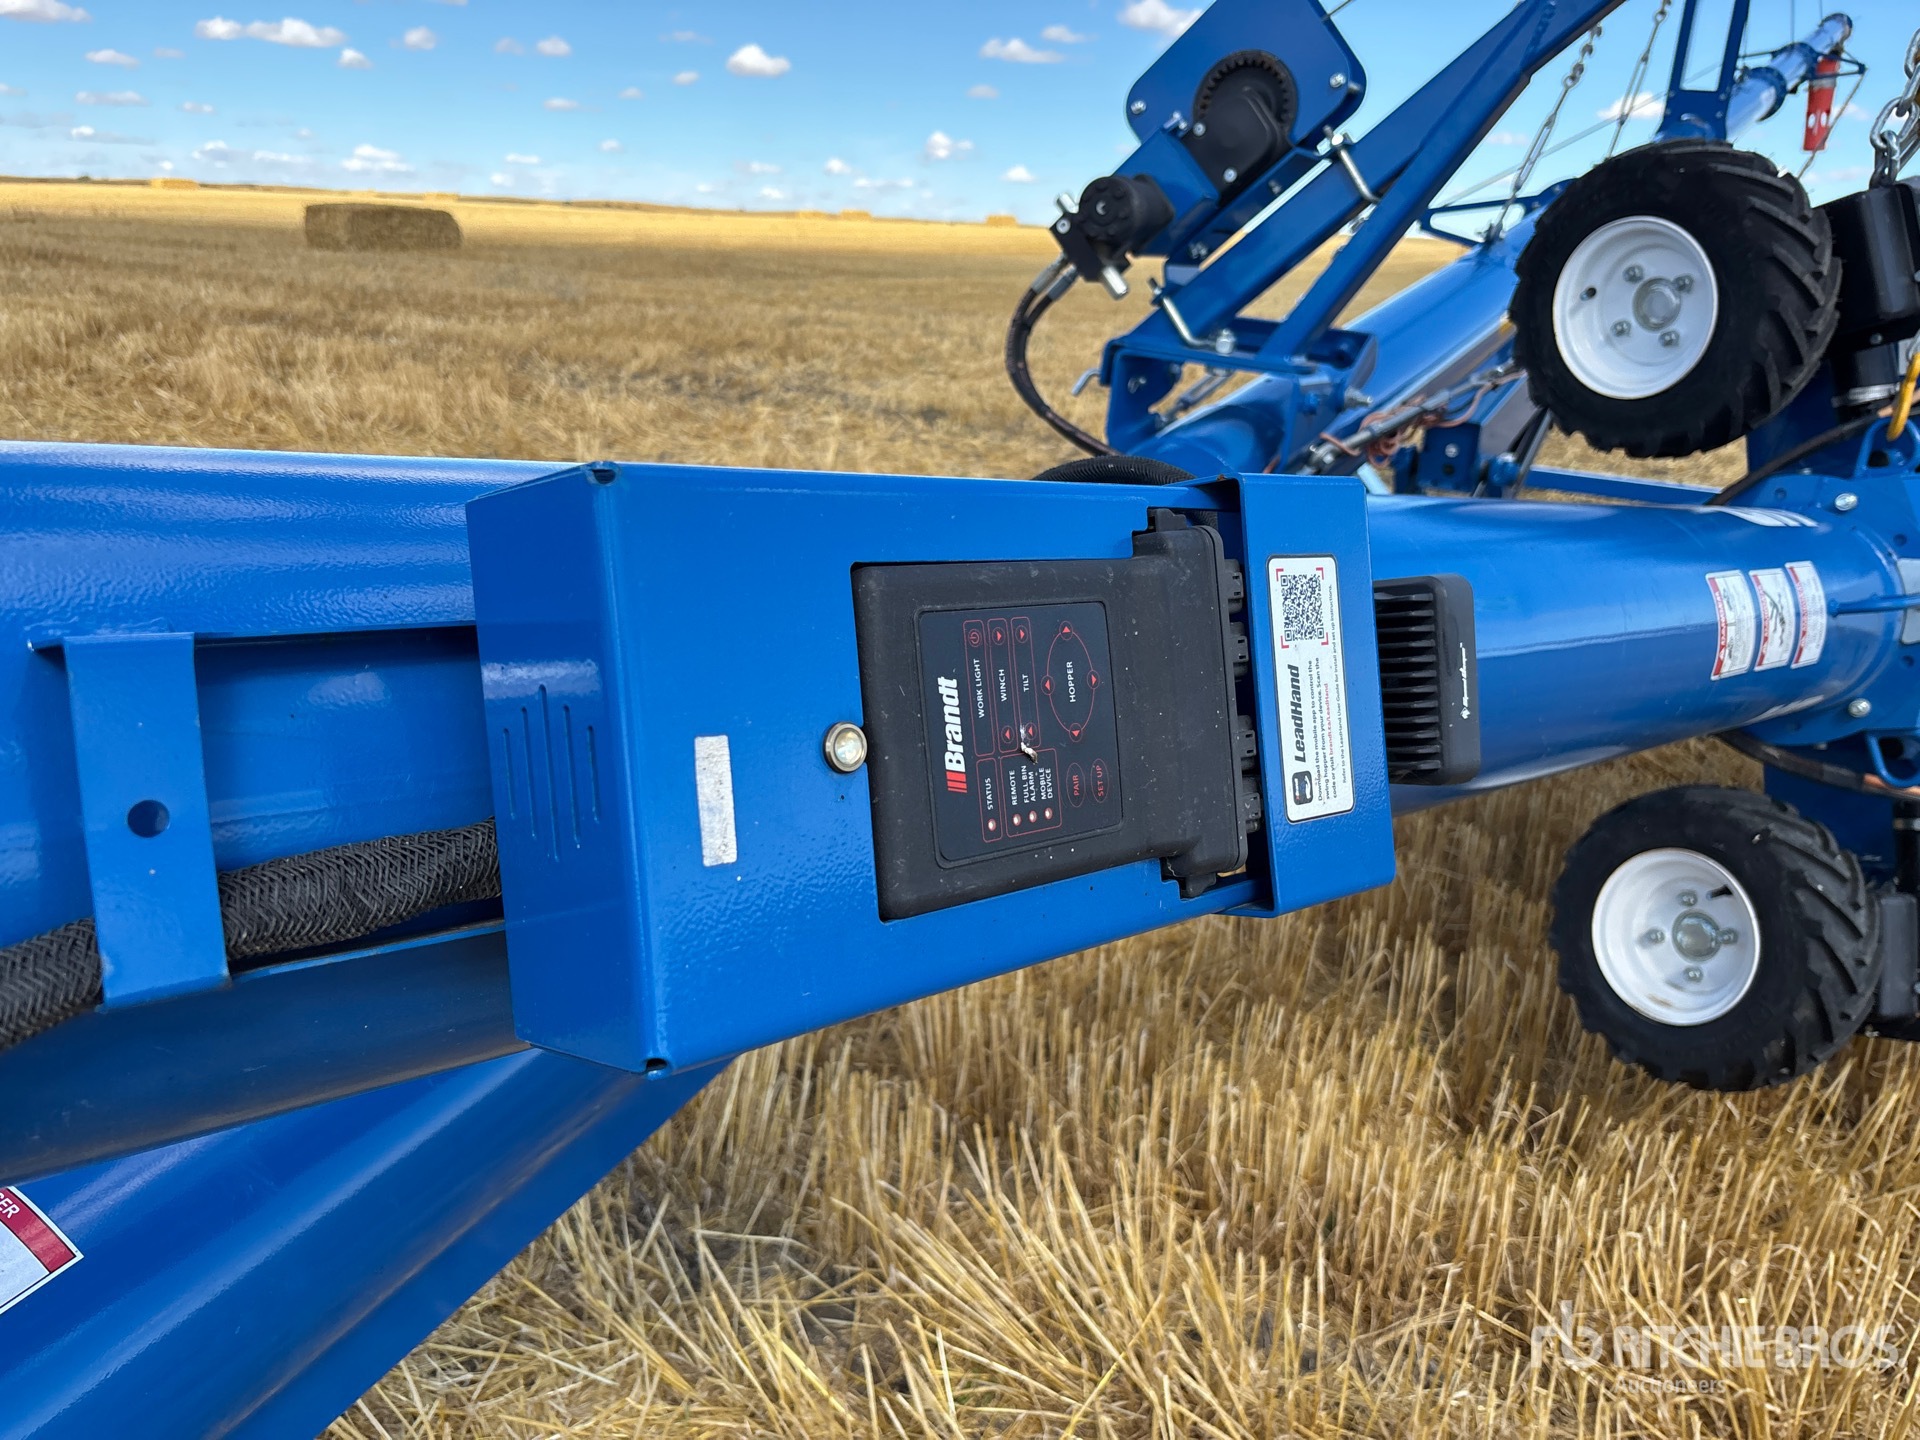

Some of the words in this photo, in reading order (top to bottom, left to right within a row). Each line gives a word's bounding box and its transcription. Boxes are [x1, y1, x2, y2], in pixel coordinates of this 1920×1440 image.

[973, 658, 982, 687] LIGHT
[999, 669, 1007, 702] WINCH
[1066, 661, 1076, 702] HOPPER
[976, 689, 985, 718] WORK
[1287, 664, 1306, 762] LeadHand
[1324, 683, 1334, 755] brandt.ca/LeadHand
[938, 676, 966, 772] Brandt
[1008, 770, 1018, 805] REMOTE
[1096, 765, 1102, 777] UP
[985, 778, 993, 810] STATUS
[0, 1192, 20, 1219] ER
